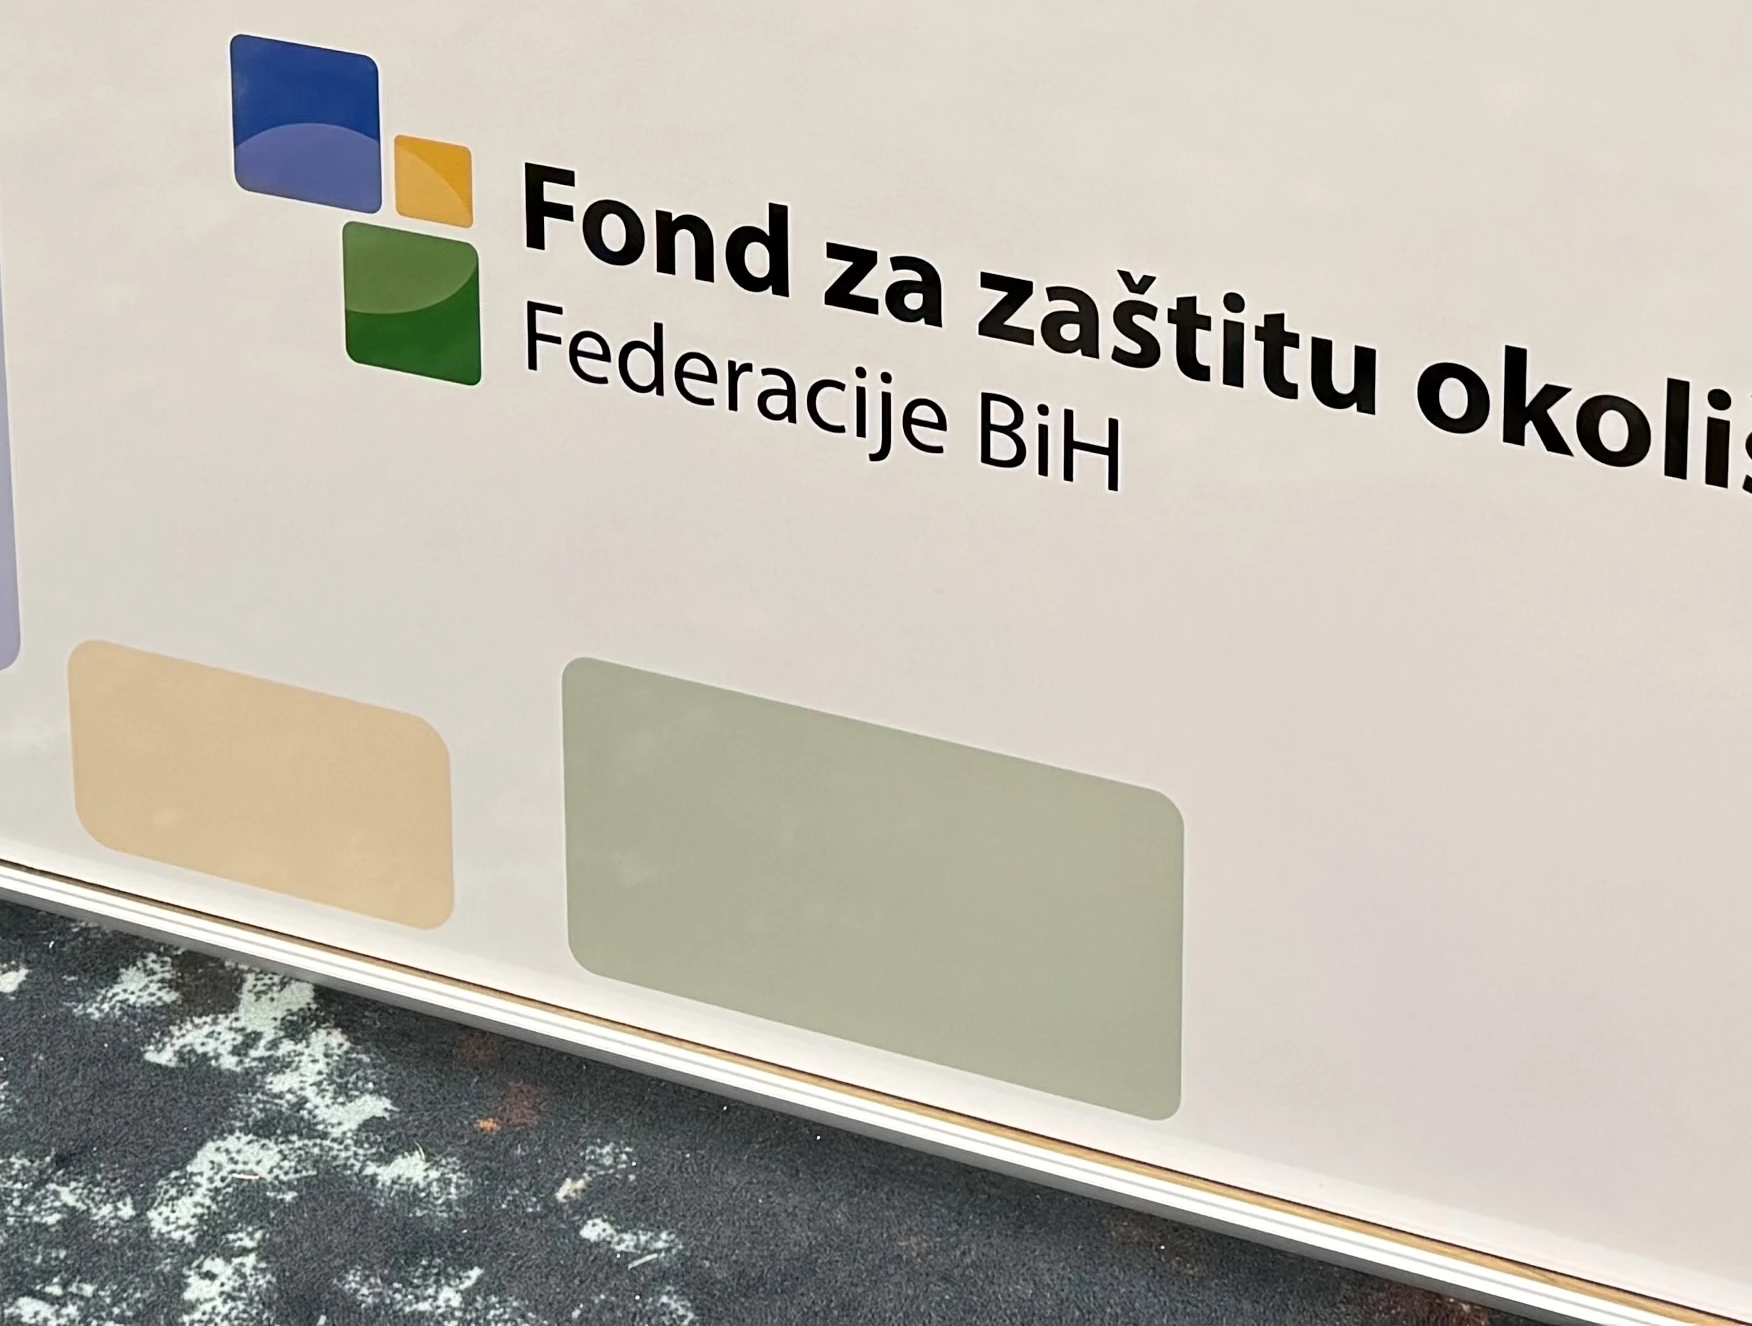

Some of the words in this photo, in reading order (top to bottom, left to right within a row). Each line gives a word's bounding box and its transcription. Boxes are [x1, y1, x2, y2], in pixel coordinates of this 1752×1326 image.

[524, 162, 790, 298] Fond
[824, 241, 943, 328] za
[978, 269, 1377, 416] zaštitu
[526, 300, 948, 462] Federacije
[980, 391, 1119, 492] BiH
